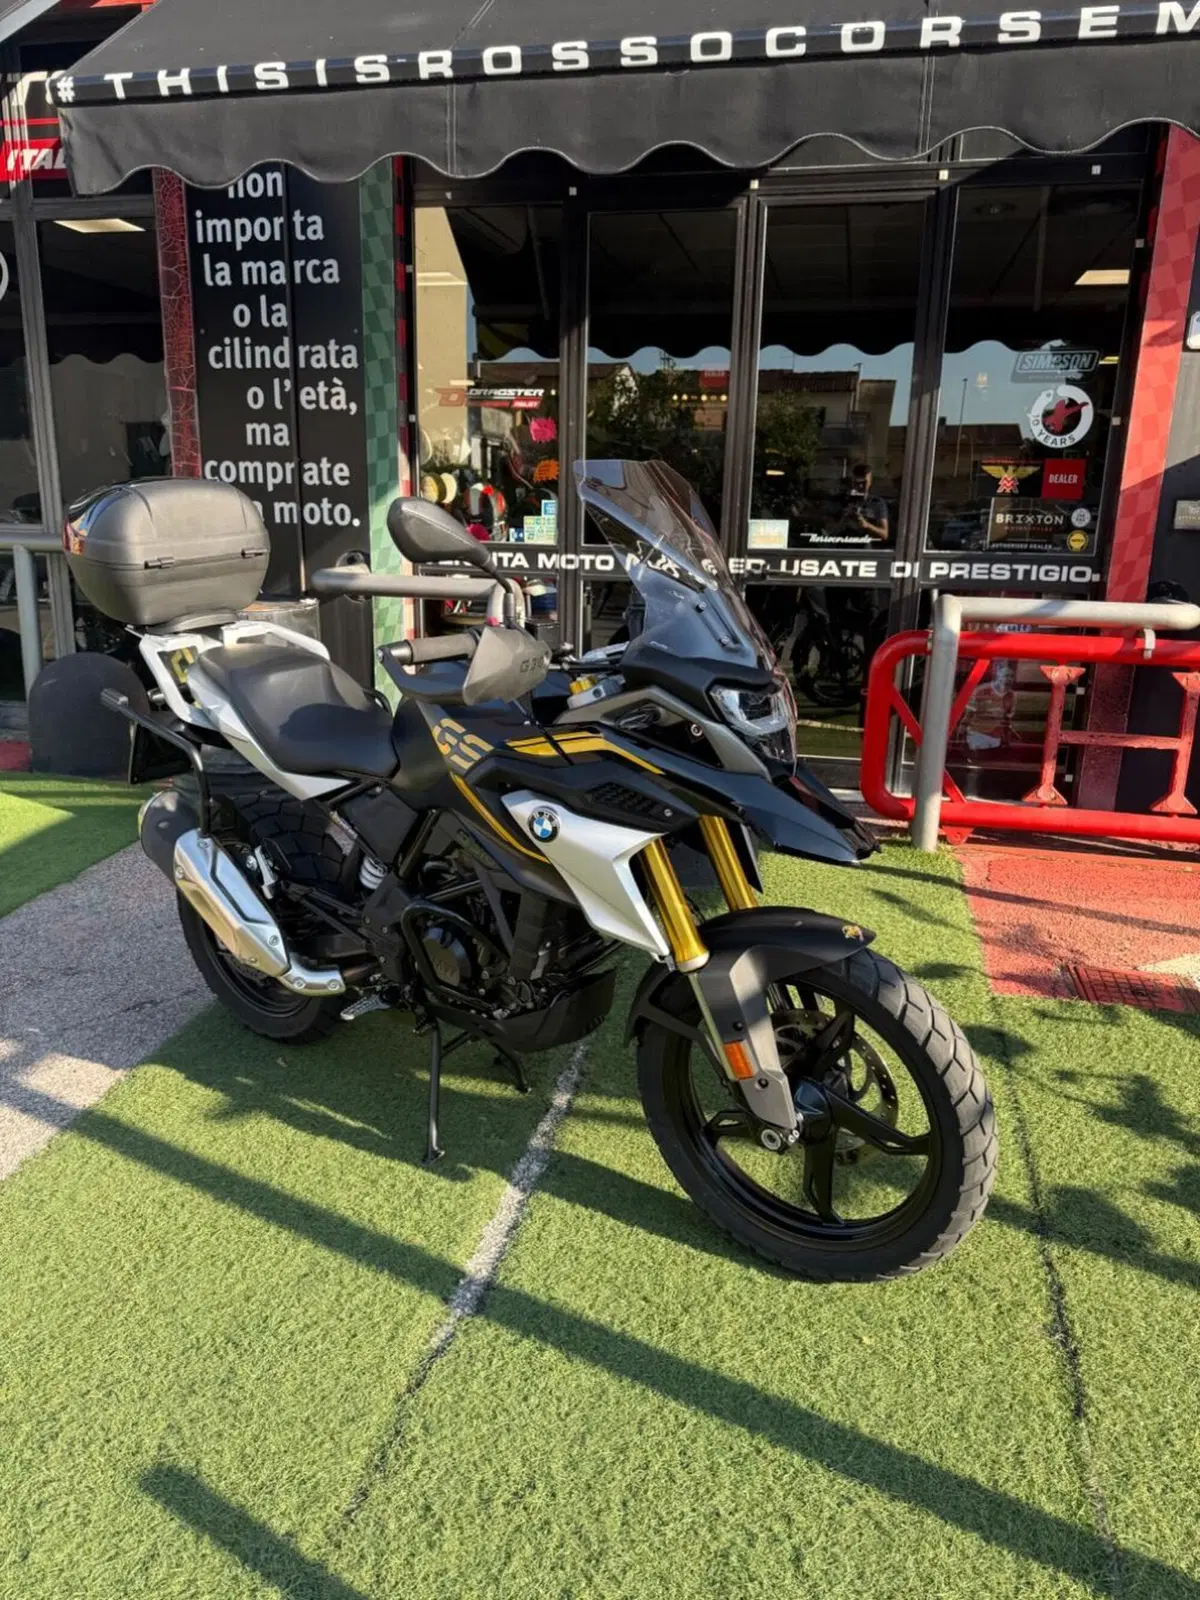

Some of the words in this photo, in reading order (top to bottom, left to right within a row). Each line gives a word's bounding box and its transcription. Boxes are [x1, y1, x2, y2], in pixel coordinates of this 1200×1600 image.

[195, 210, 324, 251] importa
[203, 254, 231, 286] la
[242, 258, 340, 285] marca
[233, 304, 250, 328] o
[261, 295, 287, 328] la
[208, 337, 358, 370] cilindrata
[1022, 353, 1093, 370] SIMPSON
[246, 387, 263, 409] o
[246, 423, 289, 446] ma
[1038, 429, 1076, 446] YEARS
[204, 457, 350, 491] comprate
[1048, 474, 1078, 484] DEALER
[273, 497, 361, 527] moto.
[995, 513, 1064, 525] BRIXTON
[537, 553, 615, 571] MOTO
[780, 559, 878, 577] USATE
[890, 560, 919, 578] DI
[929, 562, 1100, 582] PRESTIGIO.
[433, 717, 495, 771] GS
